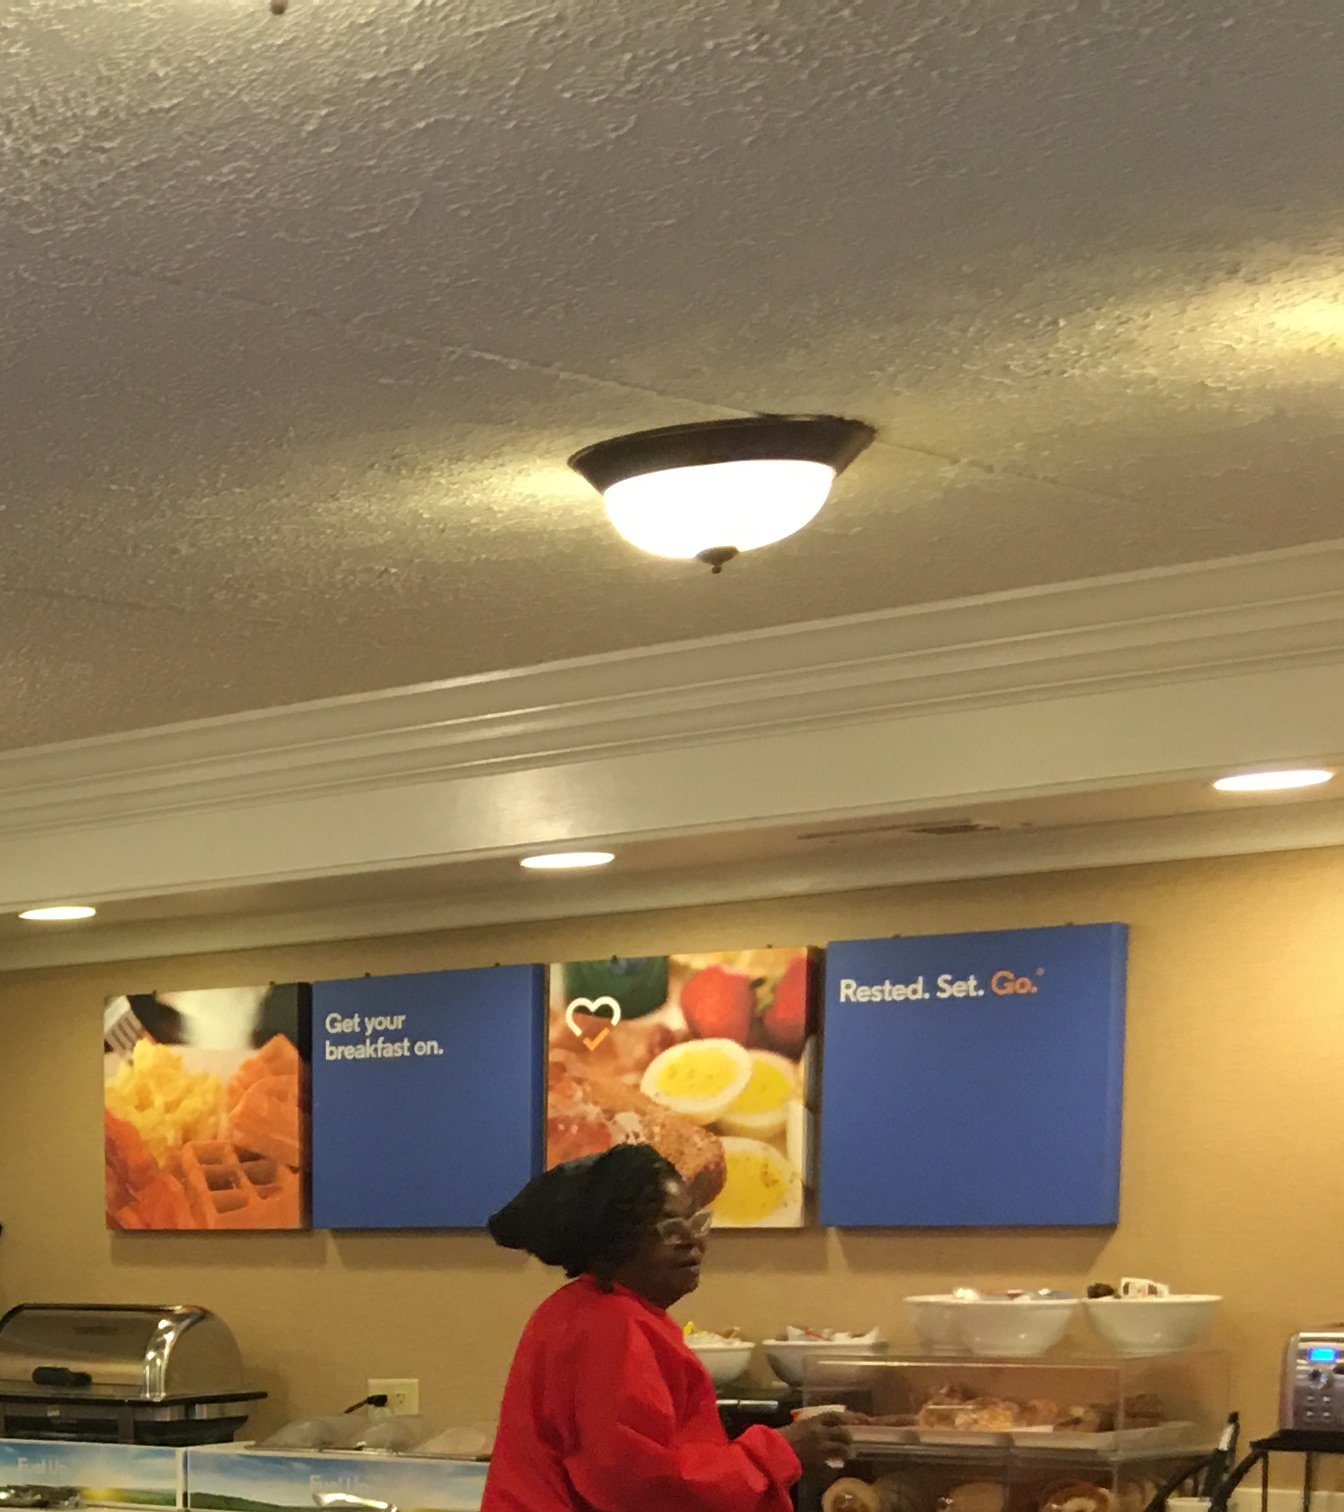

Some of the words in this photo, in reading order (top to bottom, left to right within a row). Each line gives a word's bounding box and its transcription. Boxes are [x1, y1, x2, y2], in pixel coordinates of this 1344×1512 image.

[839, 976, 930, 1002] Rested.
[936, 974, 984, 997] Set.
[325, 1013, 360, 1033] Get
[365, 1014, 406, 1035] your
[325, 1037, 410, 1060] breakfast
[414, 1040, 443, 1056] on.
[18, 1458, 46, 1473] Fuel
